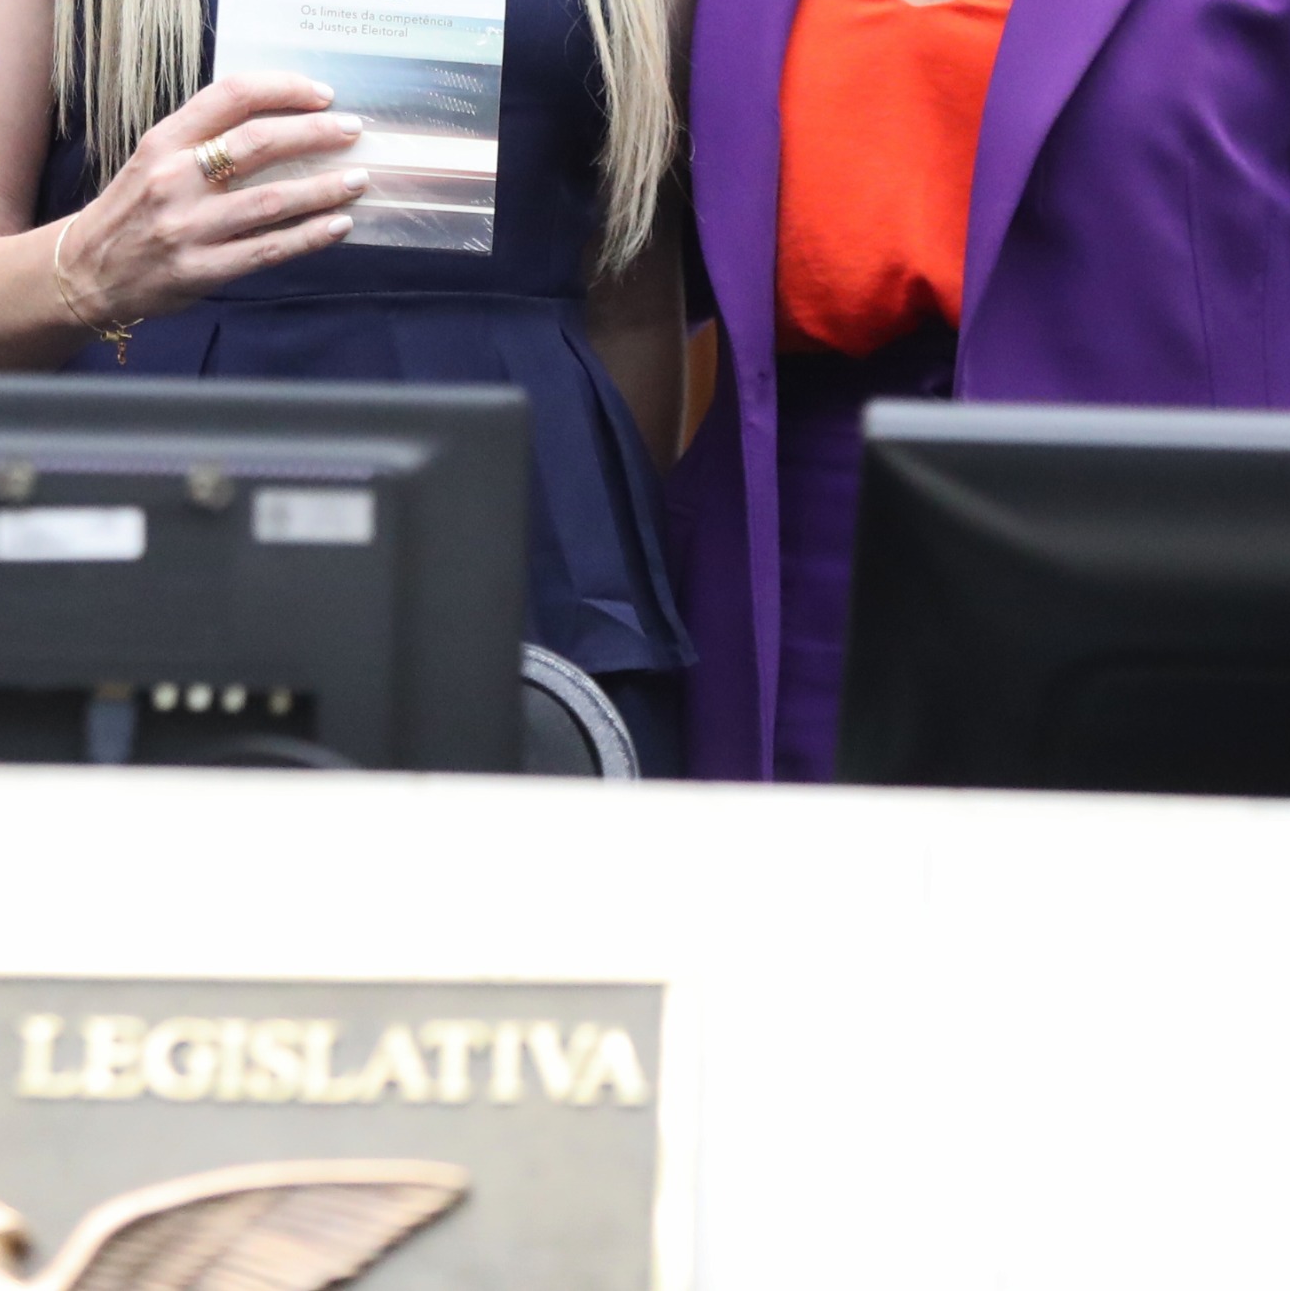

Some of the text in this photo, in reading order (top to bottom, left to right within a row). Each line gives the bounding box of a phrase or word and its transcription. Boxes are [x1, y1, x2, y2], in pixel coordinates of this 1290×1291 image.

[300, 4, 453, 28] Os limites da competência
[299, 19, 409, 38] da Justiça Eleitoral
[15, 1013, 647, 1107] LEGISLATIVA
